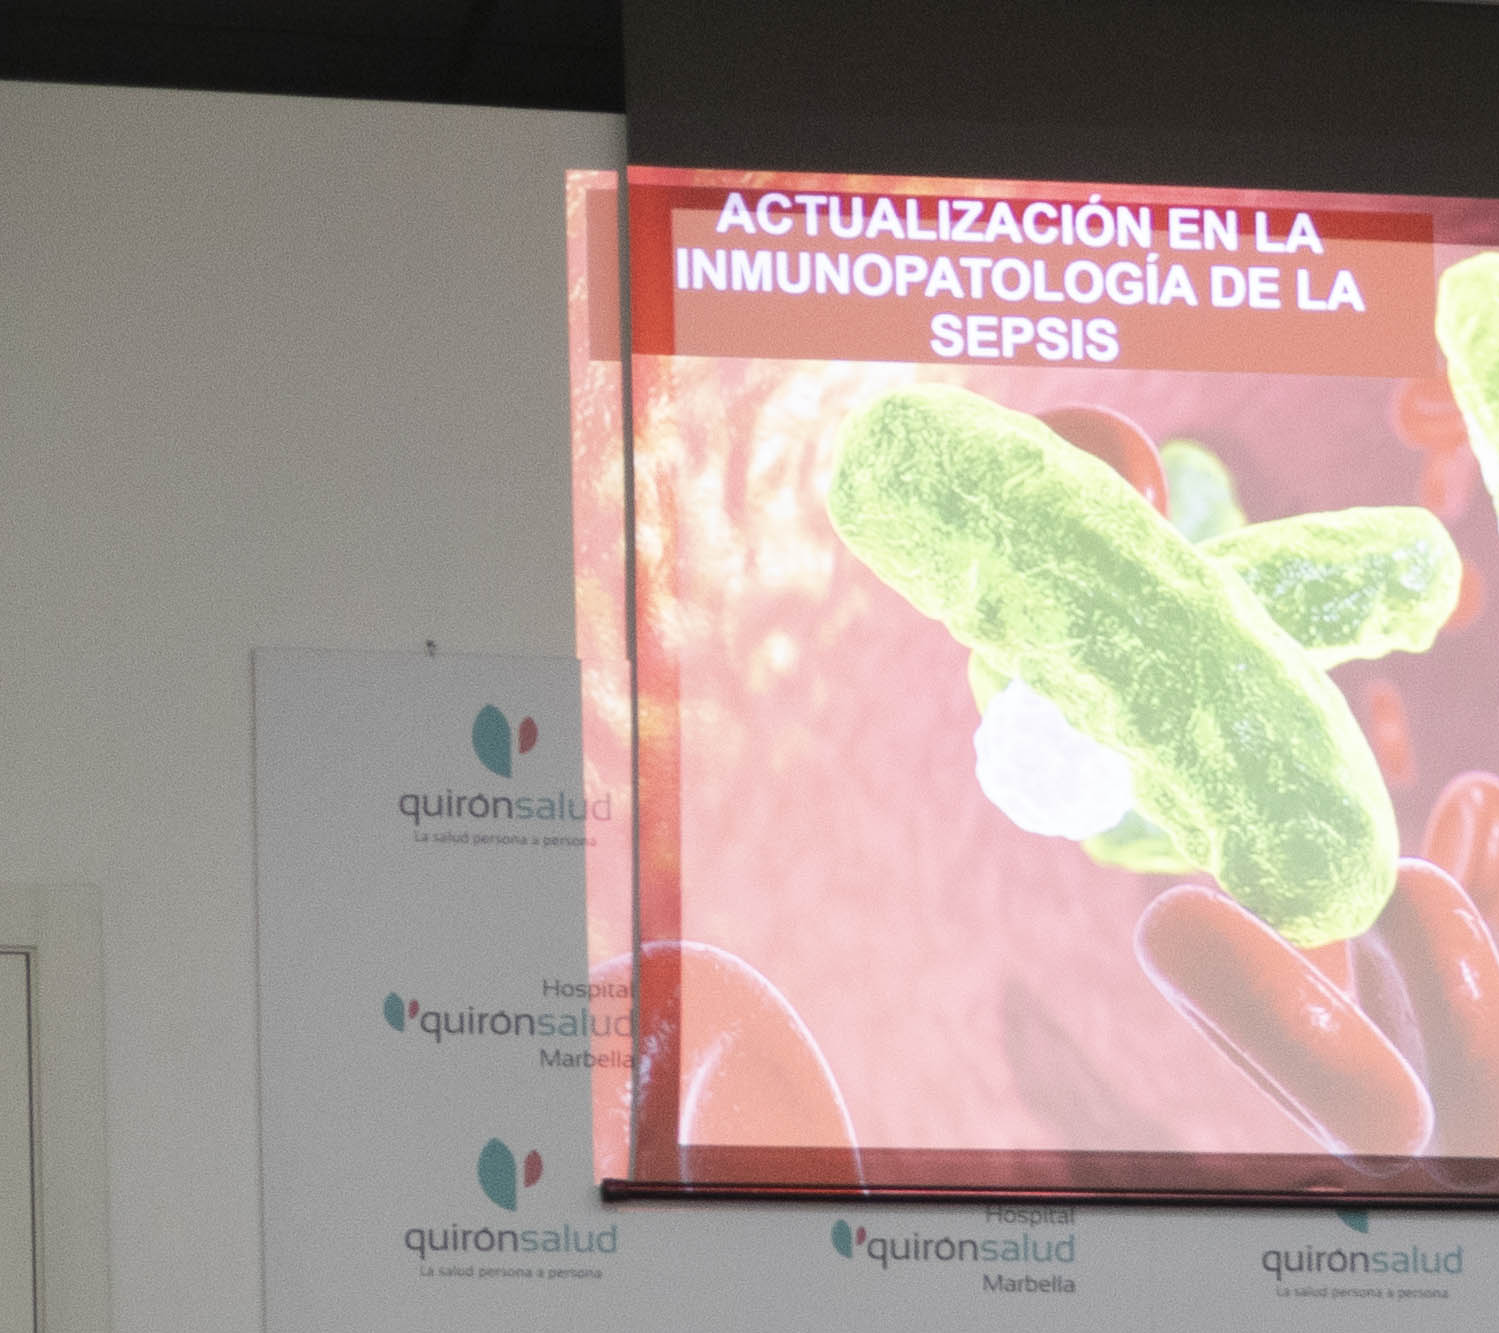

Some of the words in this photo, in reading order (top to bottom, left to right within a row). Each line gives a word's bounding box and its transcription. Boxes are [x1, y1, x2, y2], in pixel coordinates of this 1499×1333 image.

[716, 191, 1152, 248] ACTUALIZACIÓN
[1169, 207, 1239, 251] EN
[1255, 211, 1324, 255] LA
[676, 249, 1198, 308] INMUNOPATOLOGÍA
[1211, 266, 1280, 310] DE
[1296, 269, 1365, 312] LA
[930, 314, 1119, 363] SEPSIS
[983, 1274, 1076, 1294] Marbella
